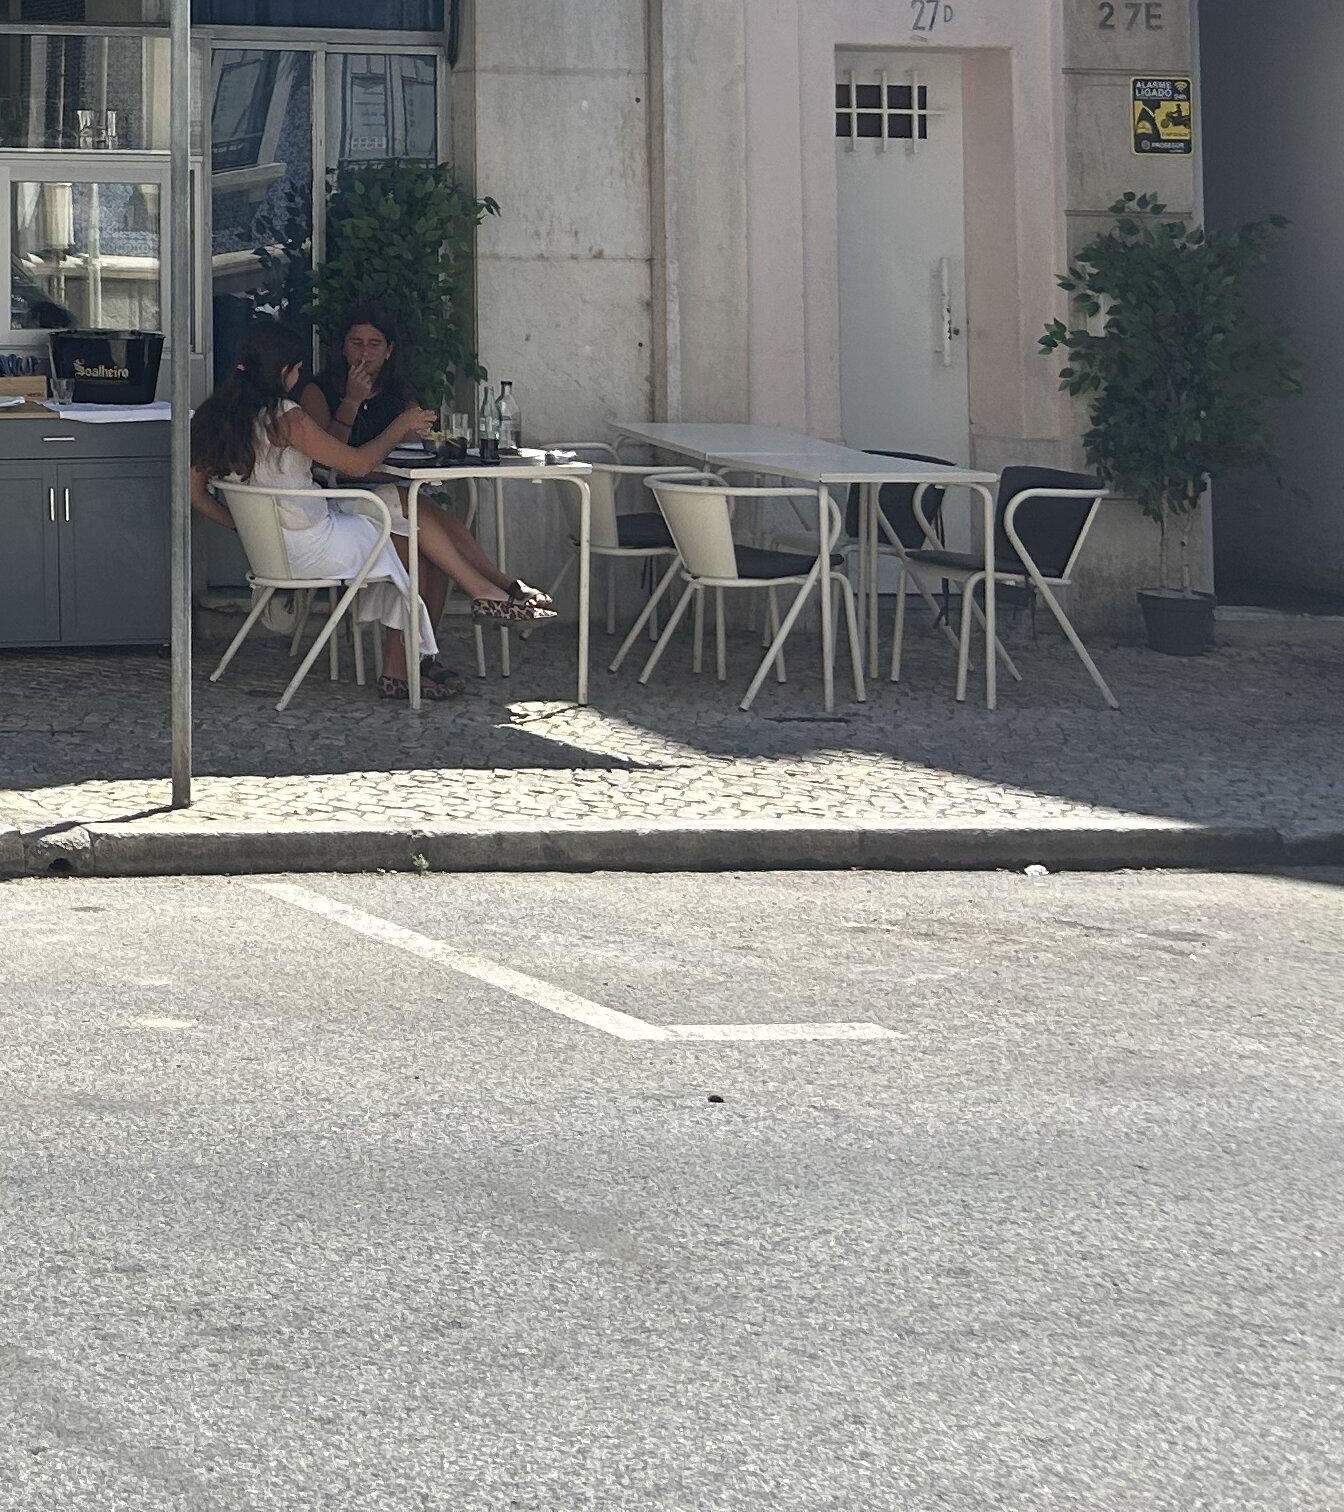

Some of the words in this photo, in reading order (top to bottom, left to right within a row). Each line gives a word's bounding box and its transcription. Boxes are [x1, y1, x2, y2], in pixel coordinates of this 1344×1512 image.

[1136, 81, 1172, 89] ALARME
[1135, 89, 1172, 97] LIGADO
[73, 359, 129, 379] Soalheiro
